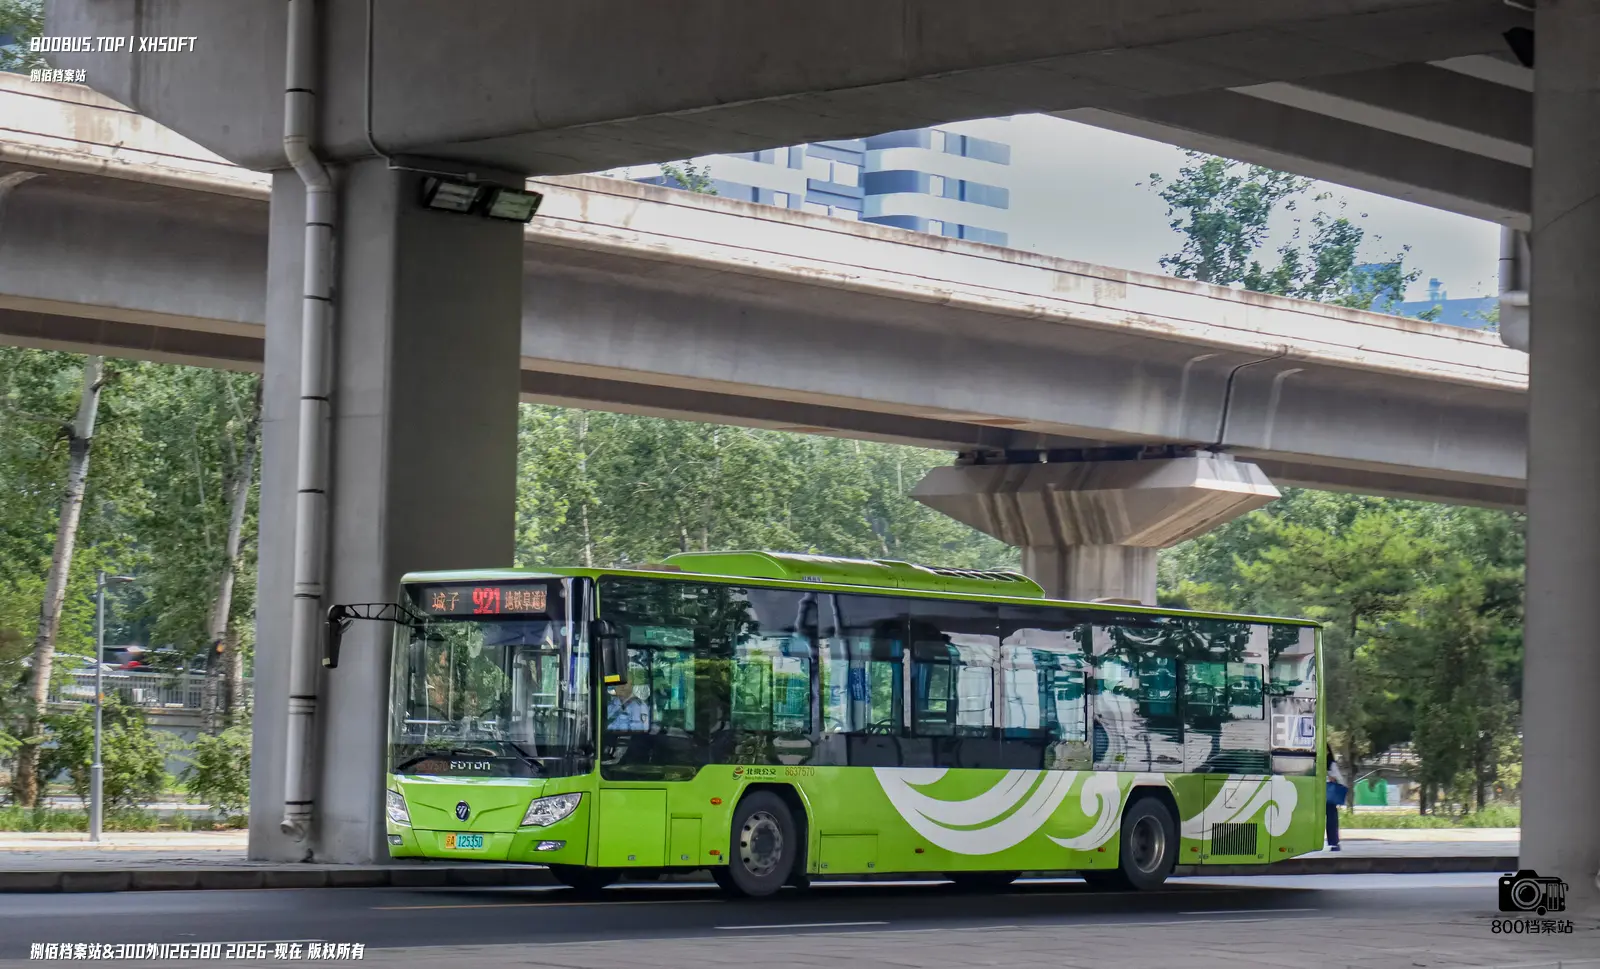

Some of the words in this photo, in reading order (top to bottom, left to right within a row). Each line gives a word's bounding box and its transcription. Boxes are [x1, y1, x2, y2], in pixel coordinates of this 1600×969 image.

[432, 592, 460, 611] 城子
[472, 587, 500, 614] 921
[785, 766, 815, 777] 8637570
